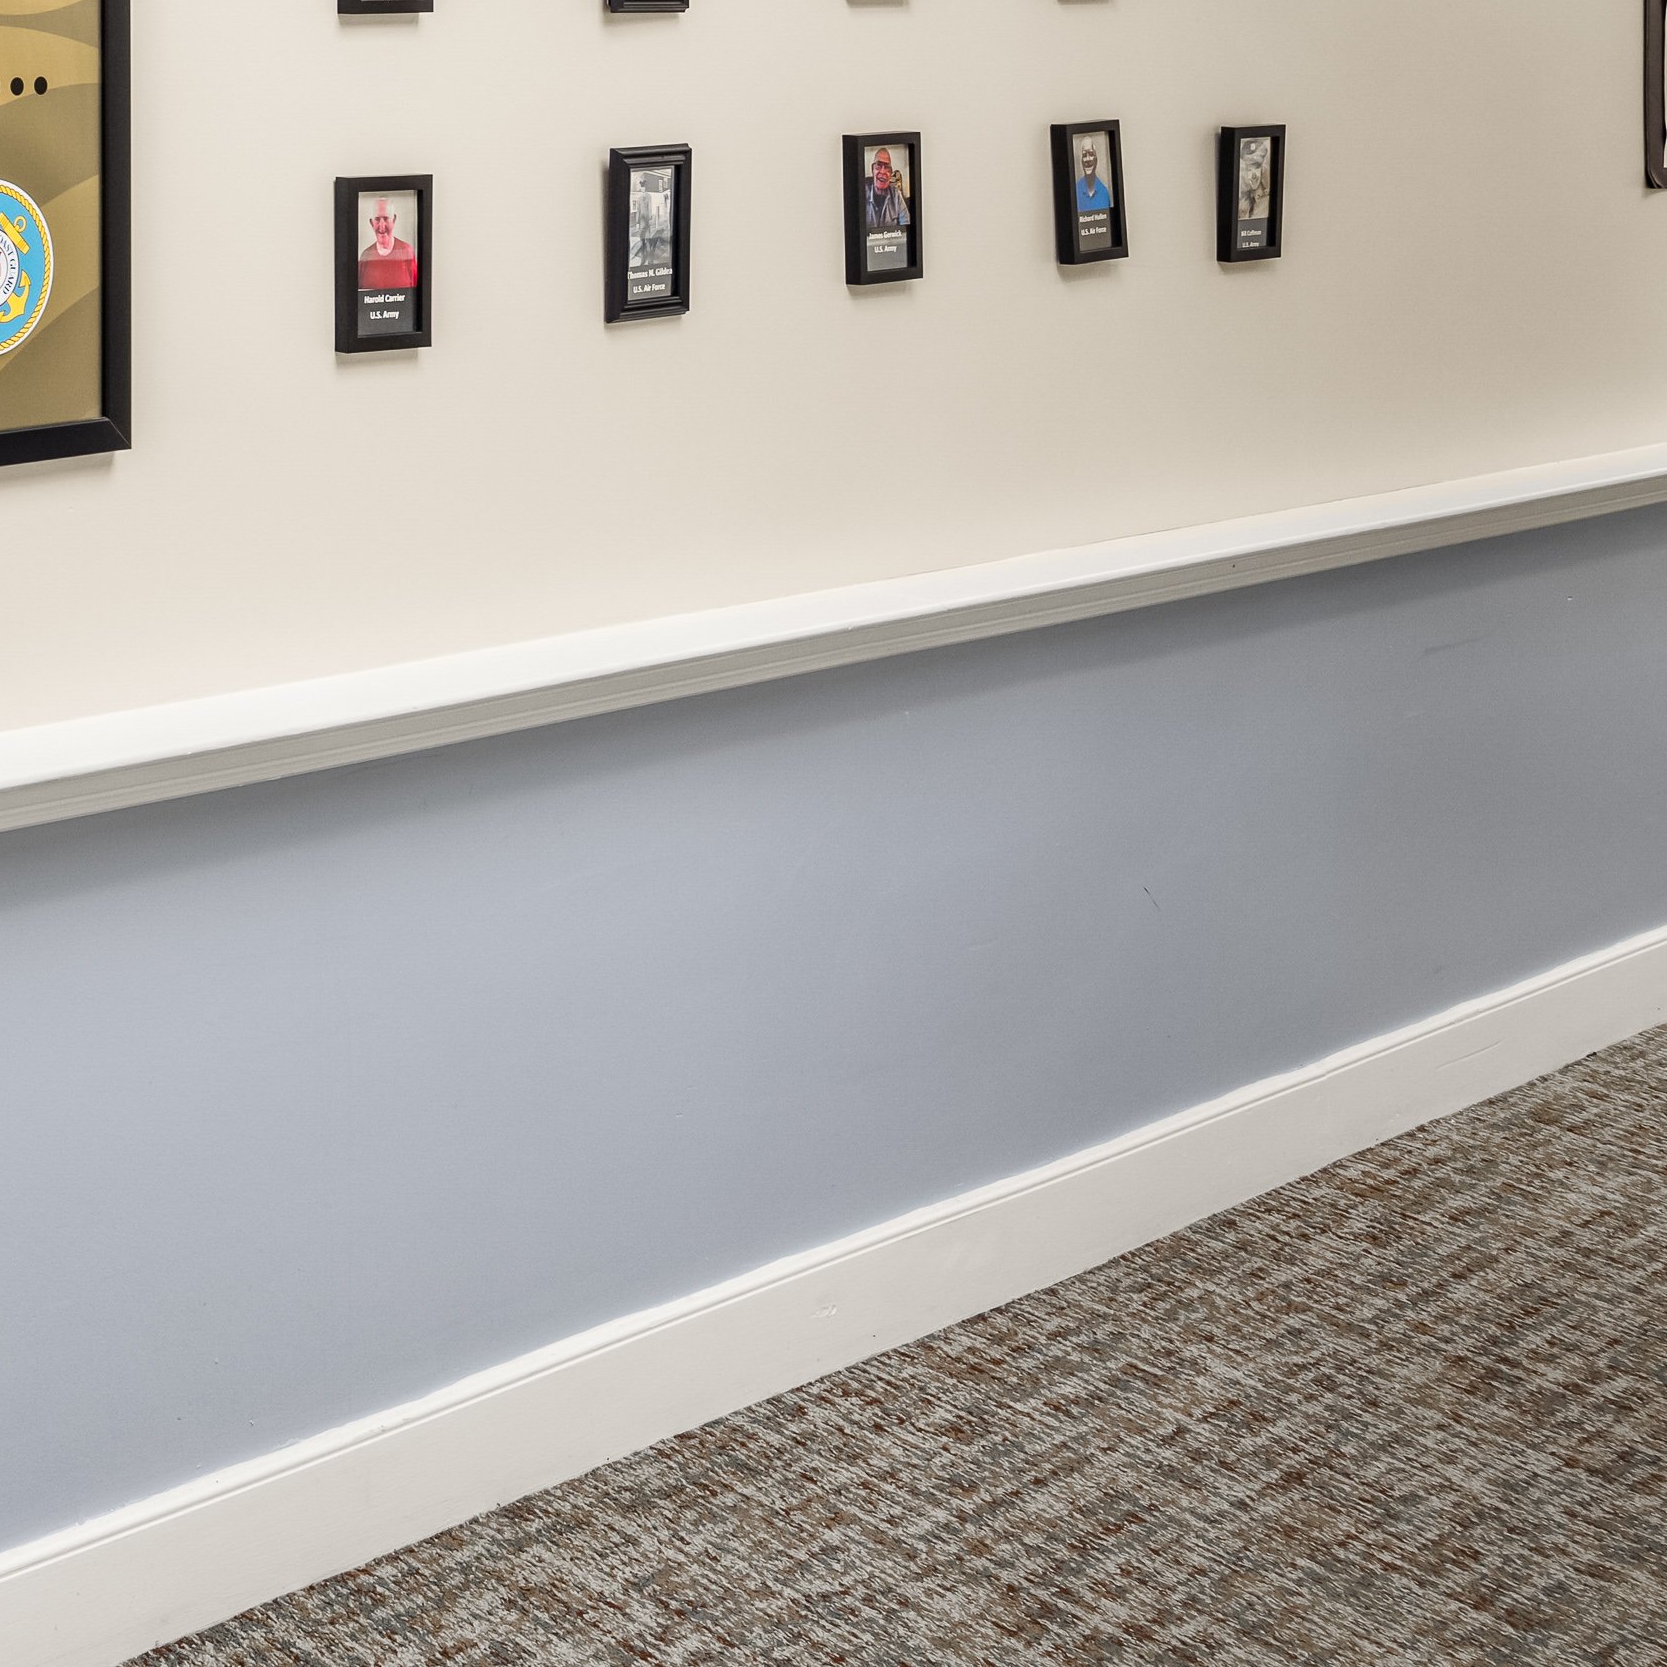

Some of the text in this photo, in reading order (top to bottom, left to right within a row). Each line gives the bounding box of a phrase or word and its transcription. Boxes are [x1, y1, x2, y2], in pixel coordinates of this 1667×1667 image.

[3, 258, 16, 295] GUARD
[633, 285, 643, 293] U.S.
[643, 284, 652, 292] Air
[364, 294, 384, 304] Harold
[370, 310, 399, 319] U.S. Army
